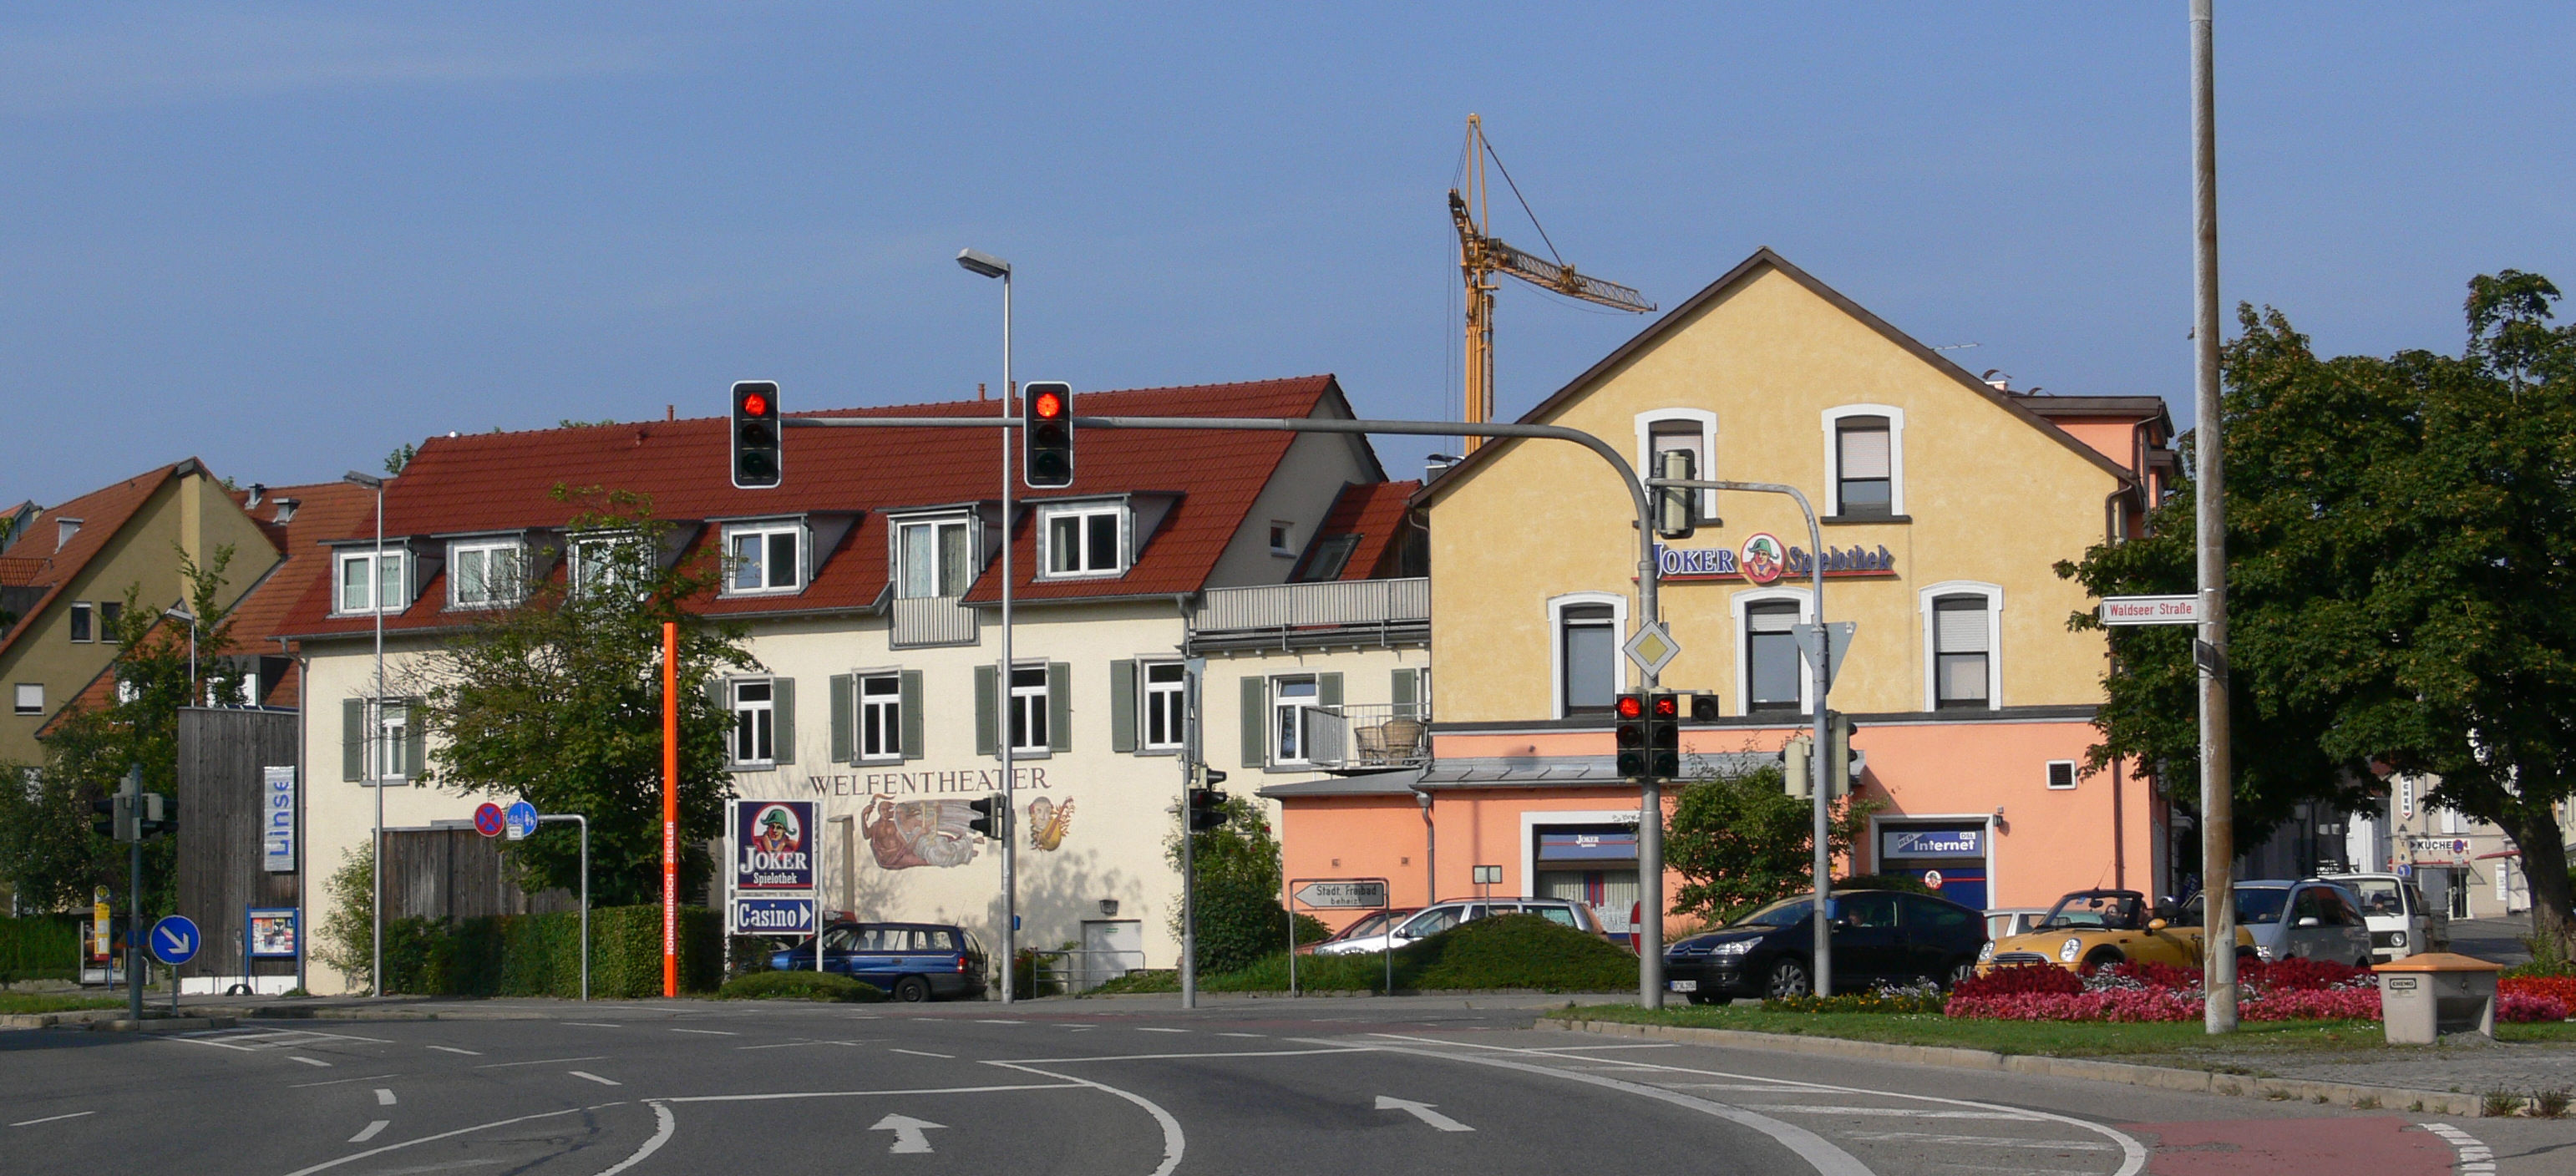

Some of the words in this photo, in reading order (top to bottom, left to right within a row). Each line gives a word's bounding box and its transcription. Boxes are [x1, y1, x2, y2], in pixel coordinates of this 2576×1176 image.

[1653, 542, 1736, 580] JOKER
[1788, 544, 1892, 576] Spelothek
[2110, 604, 2155, 616] Waldseer
[2159, 602, 2193, 615] Straße
[809, 767, 1052, 796] WELFENTHEATER
[269, 781, 290, 856] Linse
[666, 821, 674, 864] ZIEGLER
[1914, 839, 1975, 851] Internet
[740, 845, 809, 874] JOKER
[753, 872, 798, 886] Spielothek
[666, 874, 674, 956] NONNENBROICH
[739, 903, 797, 928] Casino
